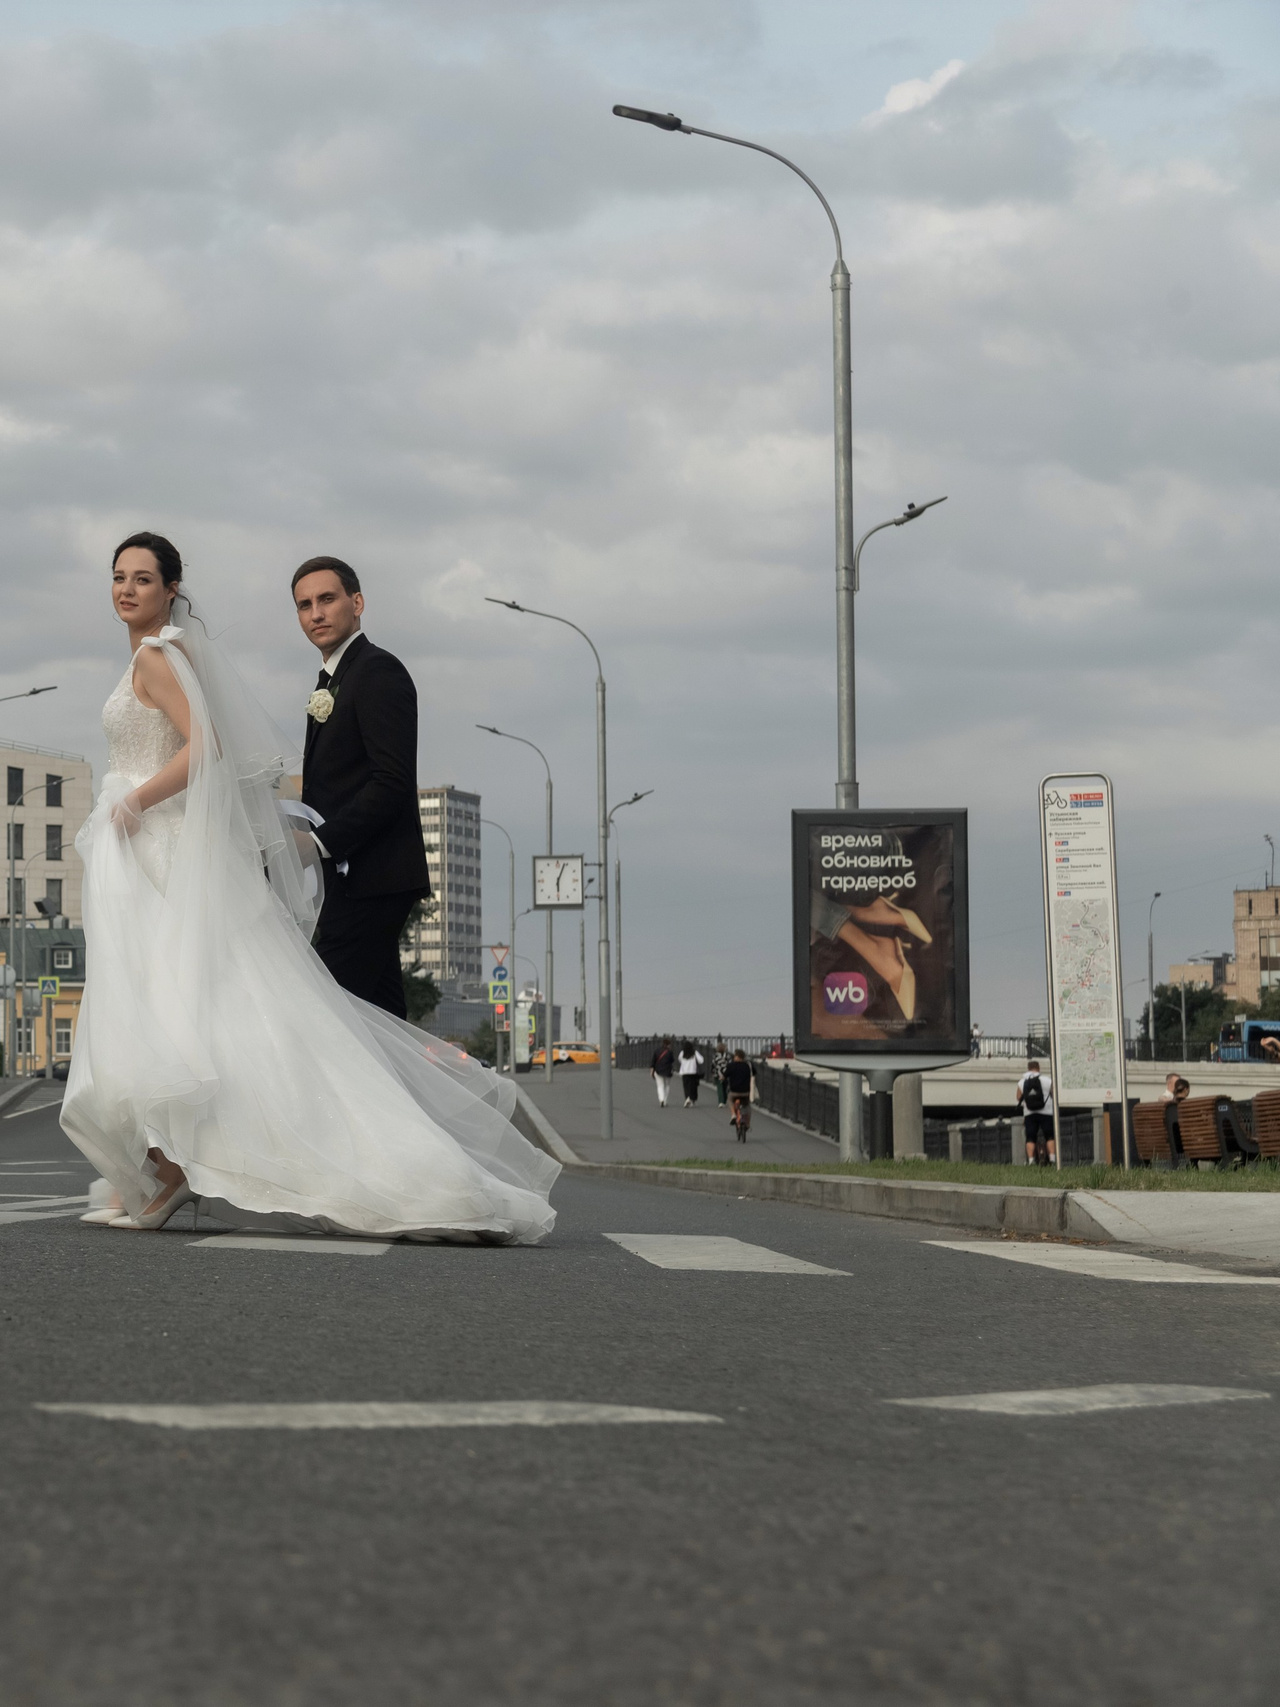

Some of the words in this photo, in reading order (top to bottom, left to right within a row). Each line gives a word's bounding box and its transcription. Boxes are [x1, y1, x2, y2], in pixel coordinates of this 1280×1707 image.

[821, 834, 883, 851] время
[821, 851, 913, 868] обновить
[821, 871, 916, 892] гардероб
[826, 980, 865, 1003] wb
